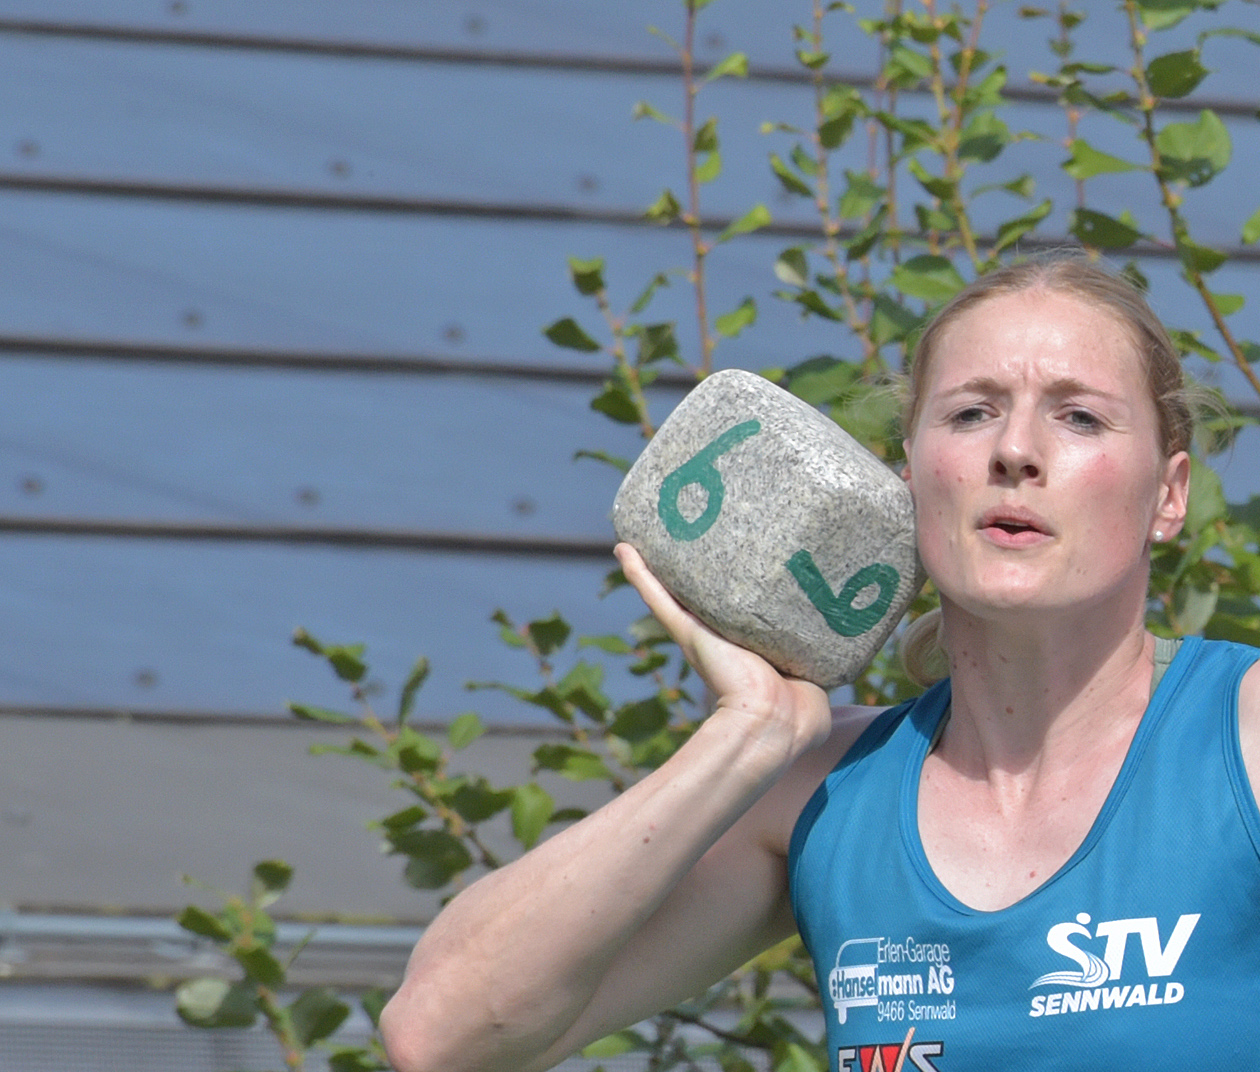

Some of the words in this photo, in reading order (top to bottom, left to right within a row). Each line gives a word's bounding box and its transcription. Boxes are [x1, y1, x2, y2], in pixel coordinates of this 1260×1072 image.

[657, 418, 761, 542] 6
[784, 549, 901, 637] 6
[877, 936, 951, 968] Erlen-Garage
[1031, 912, 1201, 988] STV
[927, 965, 955, 995] AG
[877, 1000, 905, 1022] 9466
[907, 999, 956, 1021] Sennwald
[1028, 982, 1185, 1018] SENNWALD
